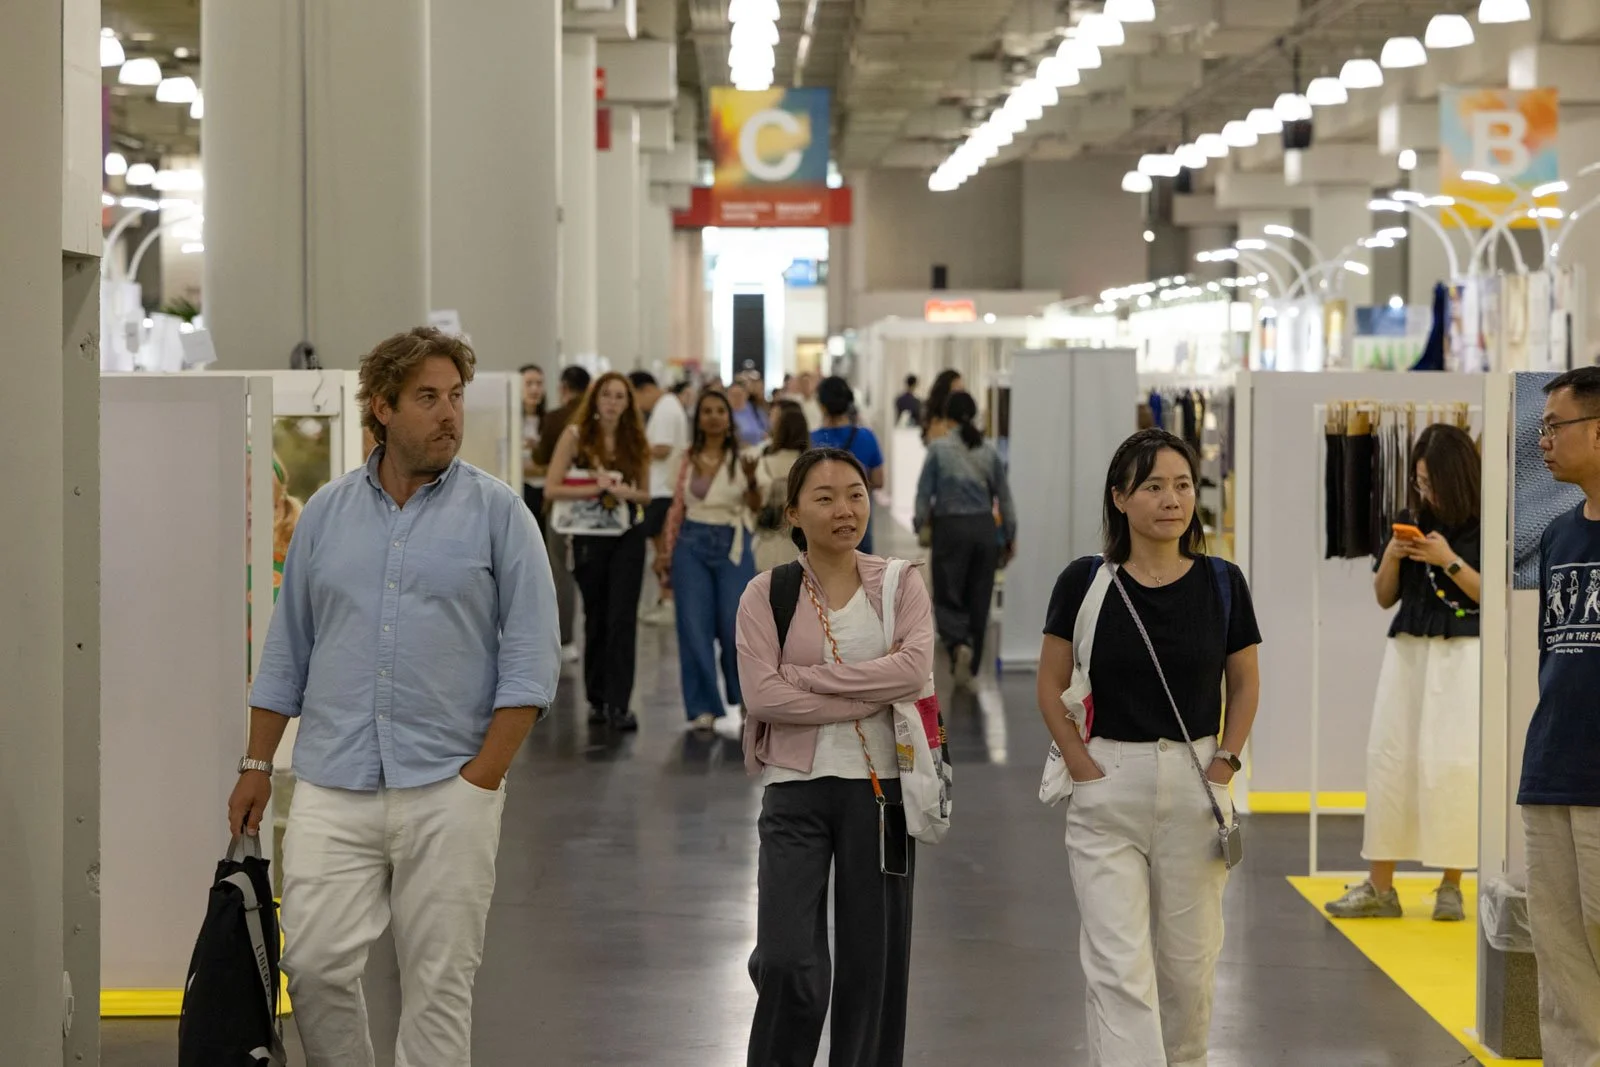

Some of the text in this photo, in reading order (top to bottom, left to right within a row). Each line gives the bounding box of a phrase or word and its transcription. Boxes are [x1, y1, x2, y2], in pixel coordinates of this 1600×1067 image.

[738, 108, 804, 182] C
[1473, 112, 1530, 178] B
[1566, 632, 1574, 641] IN
[1575, 632, 1590, 641] THE
